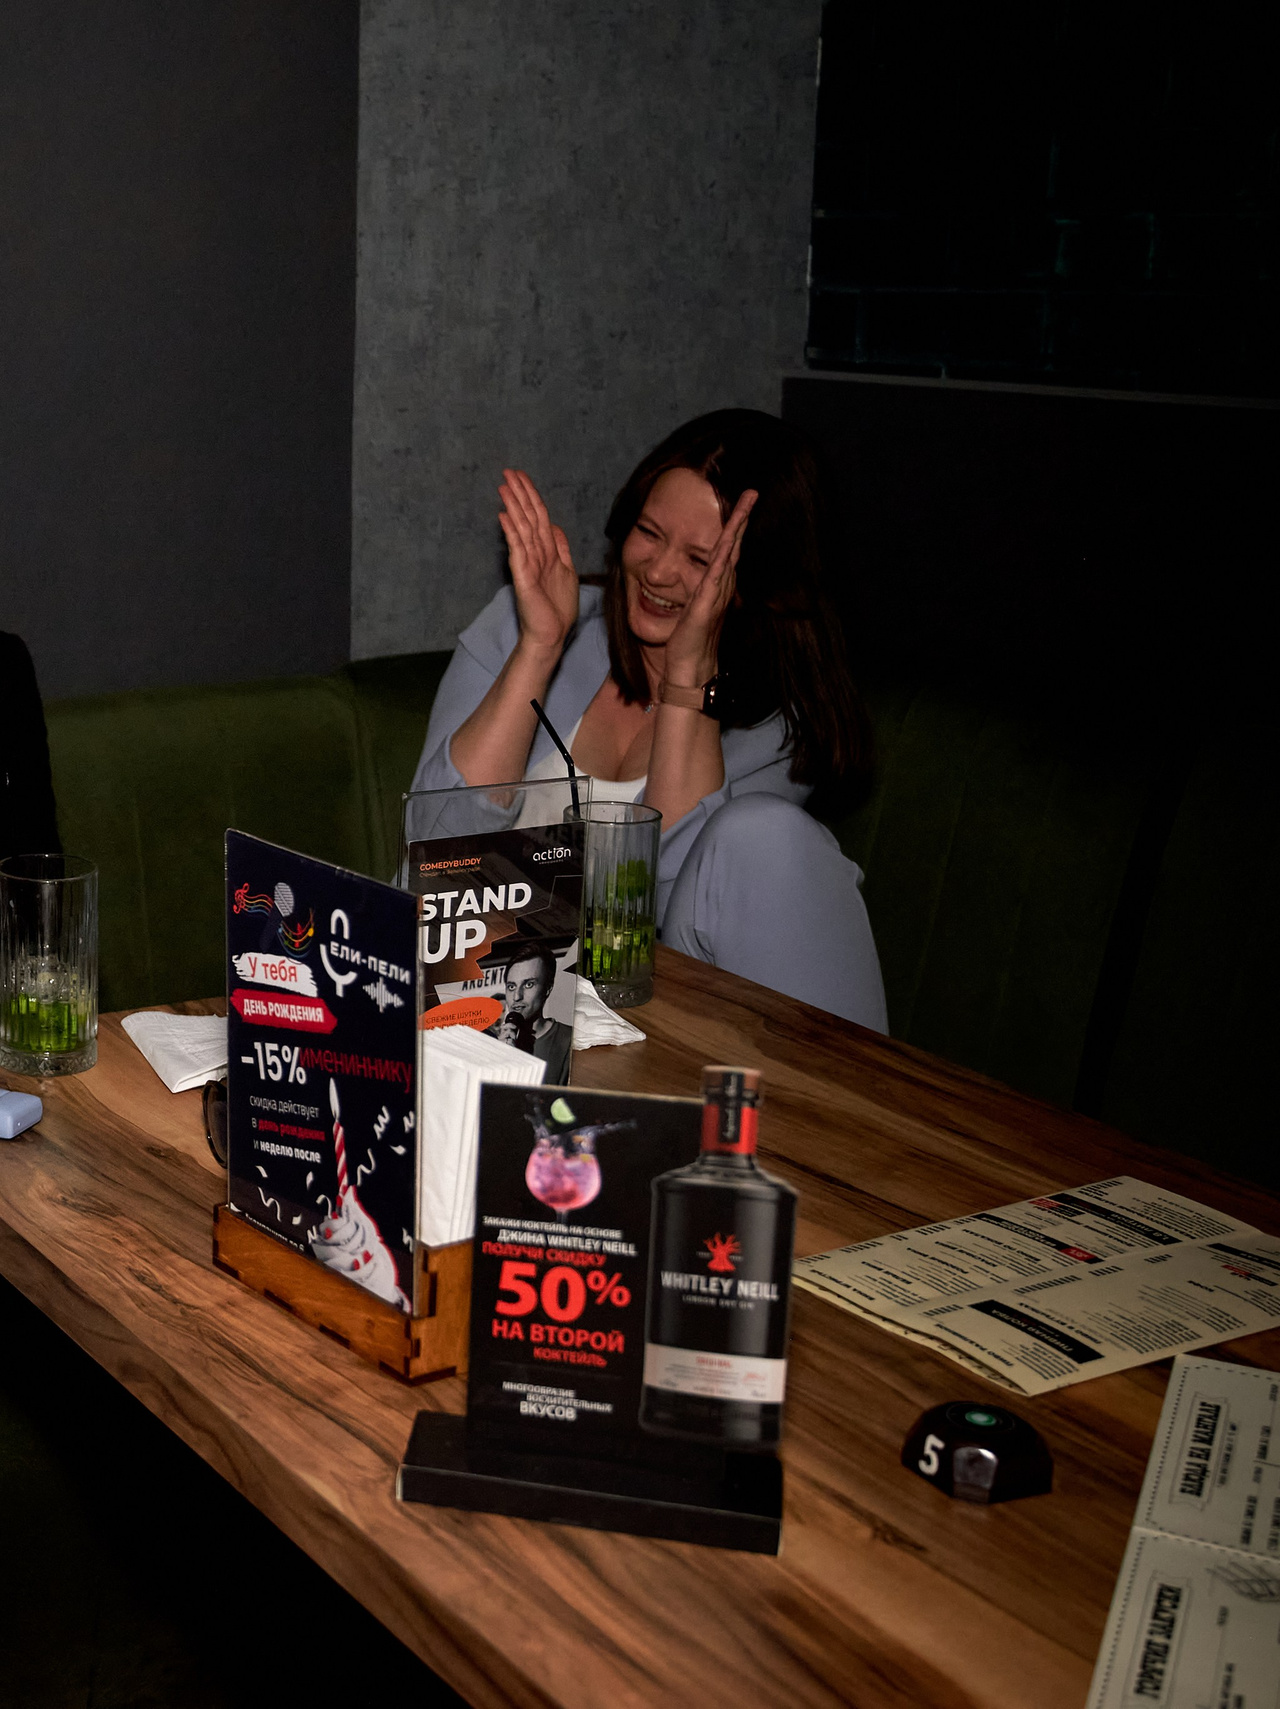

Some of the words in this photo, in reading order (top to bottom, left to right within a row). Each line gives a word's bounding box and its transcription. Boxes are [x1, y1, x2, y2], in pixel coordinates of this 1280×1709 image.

[419, 857, 481, 871] COMEDYBUDDY
[533, 847, 571, 862] action
[421, 882, 532, 921] STAND
[421, 920, 487, 964] UP
[248, 956, 257, 977] У
[262, 960, 297, 982] тебя
[330, 941, 411, 985] ЕЛИ-ПЕЛИ
[243, 998, 267, 1017] ДЕНЬ
[268, 1002, 324, 1022] РОЖДЕНИЯ
[426, 1014, 456, 1024] СВЕЖИЕ
[457, 1010, 482, 1018] ШУТКИ
[249, 1094, 278, 1111] скидка
[278, 1100, 320, 1120] действует
[251, 1118, 258, 1128] в
[253, 1139, 259, 1149] и
[260, 1141, 294, 1158] неделю
[294, 1150, 321, 1163] после
[482, 1216, 521, 1228] ЗАКАЖИ
[522, 1219, 569, 1234] КОКТЕЙЛЬ
[569, 1224, 583, 1235] НА
[583, 1226, 623, 1239] ОСНОВЕ
[482, 1241, 543, 1258] ПОЛУЧИ
[545, 1248, 607, 1266] СКИДКУ
[497, 1229, 545, 1244] ДЖИНА
[547, 1234, 600, 1250] WHITLEY
[602, 1242, 638, 1256] NEILL
[495, 1259, 632, 1323] 50%
[661, 1271, 733, 1297] WHITLEY
[736, 1280, 780, 1302] NEILL
[491, 1318, 525, 1342] НА
[530, 1323, 625, 1354] ВТОРОЙ
[533, 1348, 608, 1368] КОКТЕЙЛЬ
[502, 1381, 576, 1398] МНОГООБРАЗИЕ
[520, 1402, 577, 1420] ВКУСОВ
[526, 1393, 614, 1413] ВОСХИТИТЕЛЬНЫХ
[1192, 1401, 1221, 1446] МАНГАЛЕ
[918, 1434, 945, 1476] 5
[1187, 1446, 1210, 1462] НА
